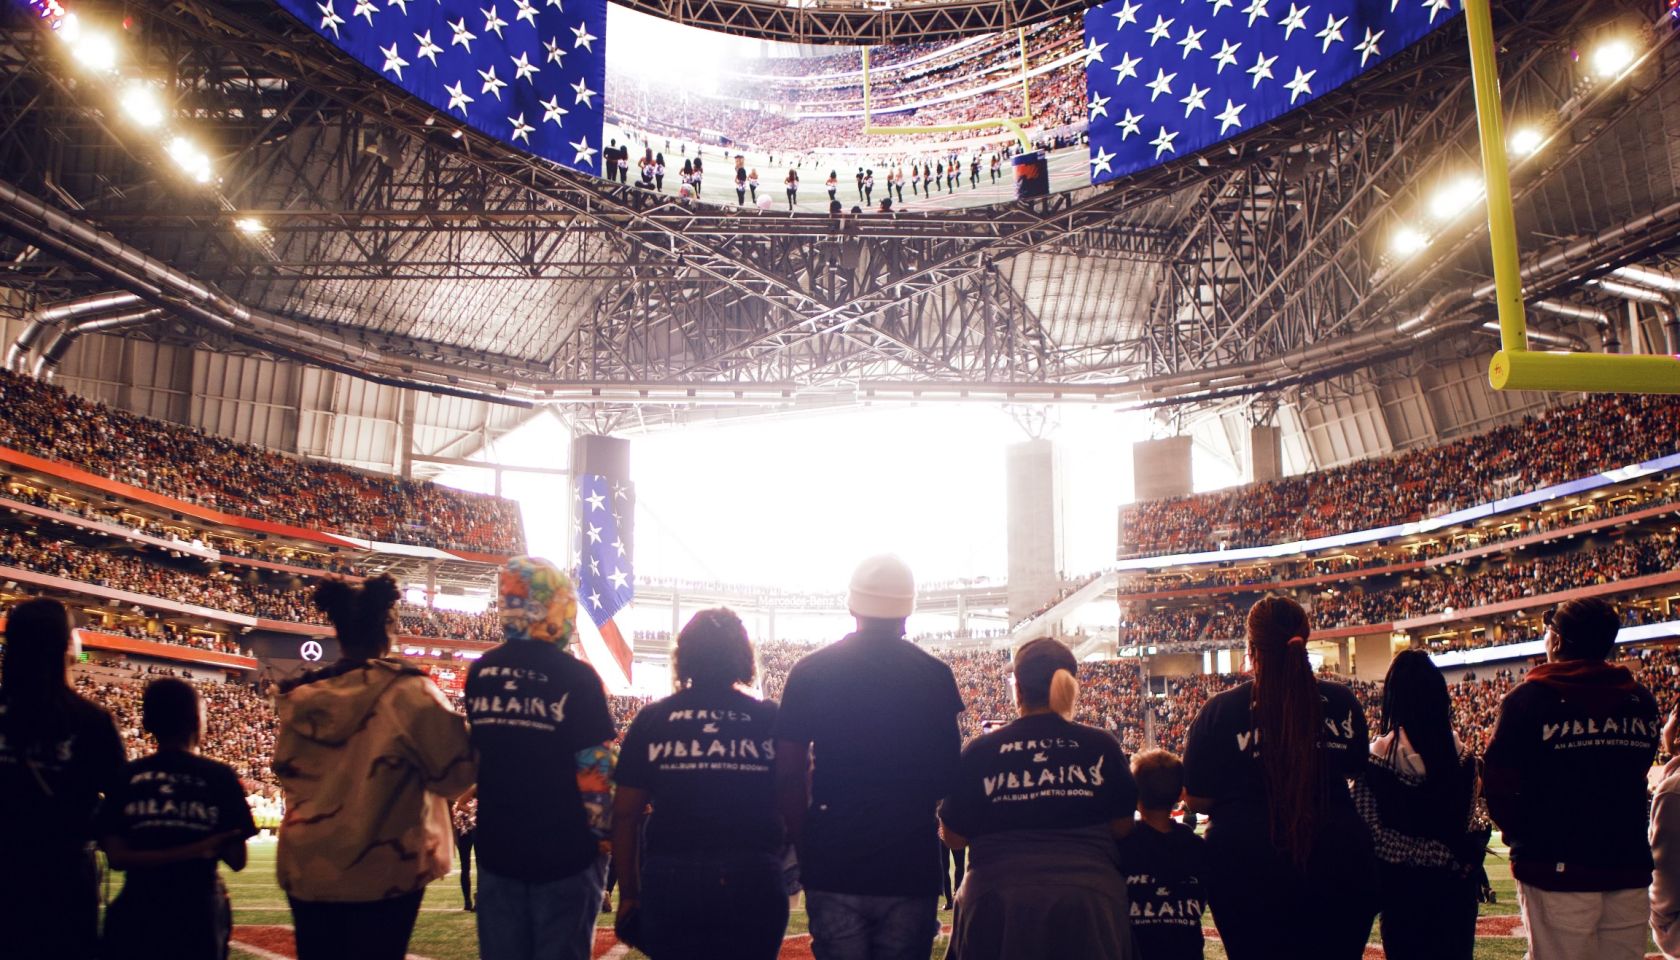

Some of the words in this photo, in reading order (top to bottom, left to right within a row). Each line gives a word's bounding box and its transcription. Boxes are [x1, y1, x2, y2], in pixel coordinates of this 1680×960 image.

[758, 594, 834, 607] Mercedes-Benz
[668, 709, 752, 722] HEROES
[703, 722, 719, 733] &
[1542, 716, 1661, 741] VILLAINS
[648, 737, 776, 762] VILLAINS
[999, 738, 1080, 754] HEROES
[1568, 739, 1593, 748] ALBUM
[1594, 739, 1605, 747] BY
[1606, 739, 1629, 747] METRO
[1033, 751, 1048, 762] &
[711, 762, 738, 770] METRO
[983, 754, 1105, 796] VILLAINS
[1002, 793, 1029, 802] ALBUM
[1040, 789, 1066, 797] METRO
